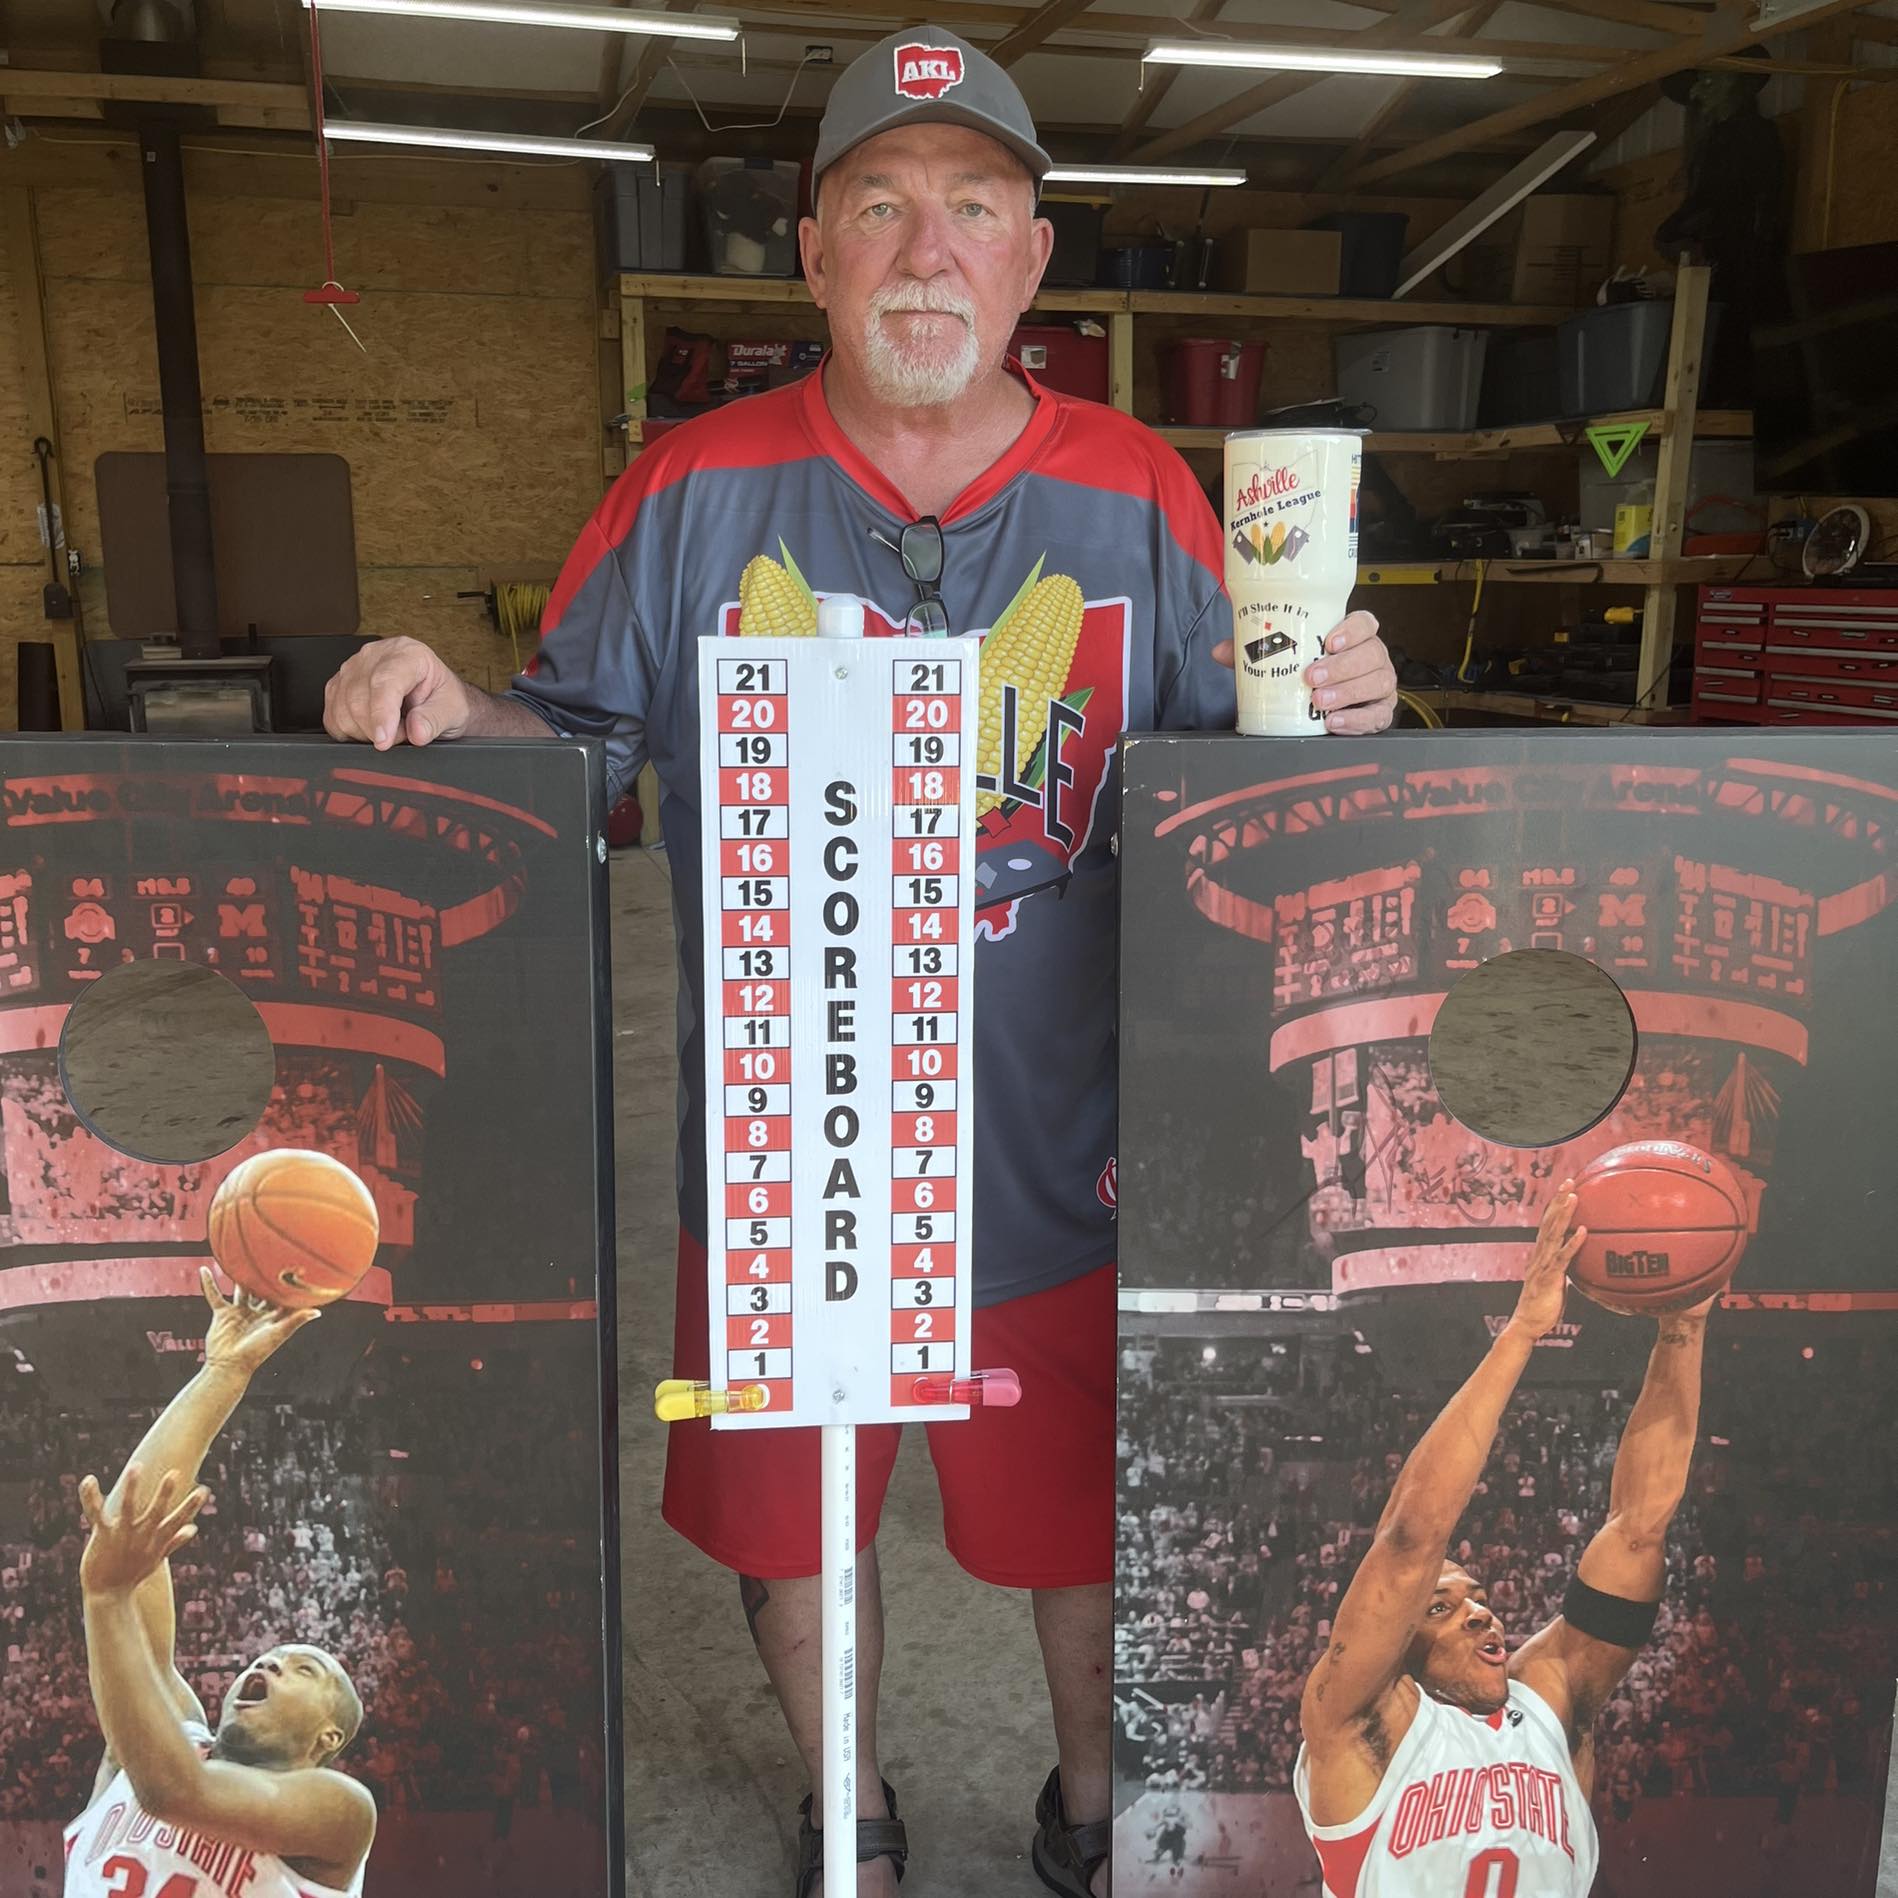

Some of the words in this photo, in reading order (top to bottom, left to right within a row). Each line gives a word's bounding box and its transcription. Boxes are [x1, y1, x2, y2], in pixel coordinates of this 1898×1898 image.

[901, 60, 957, 83] AKL
[1237, 467, 1300, 511] Ashville
[1230, 506, 1275, 532] Kernhole
[1277, 489, 1321, 511] League
[1250, 602, 1279, 614] Slide
[736, 664, 769, 690] 21
[911, 665, 943, 691] 21
[1242, 660, 1267, 679] Your
[1271, 663, 1300, 678] Hole
[732, 700, 774, 728] 20
[906, 700, 948, 728] 20
[736, 737, 771, 764] 19
[910, 737, 943, 763] 19
[737, 772, 772, 800] 18
[910, 772, 944, 800] 18
[739, 810, 770, 835] 17
[911, 808, 941, 834] 17
[737, 844, 772, 871] 16
[909, 843, 943, 870] 16
[739, 880, 772, 906] 15
[909, 879, 942, 904] 15
[739, 915, 773, 941] 14
[909, 913, 942, 939] 14
[740, 950, 773, 976] 13
[909, 948, 941, 973] 13
[740, 985, 773, 1011] 12
[909, 982, 941, 1008] 12
[745, 1020, 769, 1044] 11
[822, 781, 861, 1302] SCOREBOARD
[913, 1016, 937, 1041] 11
[740, 1053, 775, 1079] 10
[908, 1049, 942, 1075] 10
[749, 1088, 767, 1113] 9
[916, 1083, 934, 1108] 9
[749, 1121, 767, 1146] 8
[915, 1116, 934, 1142] 8
[750, 1155, 766, 1179] 7
[916, 1150, 932, 1174] 7
[749, 1187, 768, 1213] 6
[915, 1182, 933, 1208] 6
[750, 1221, 768, 1246] 5
[915, 1216, 932, 1239] 5
[749, 1254, 769, 1278] 4
[914, 1248, 933, 1272] 4
[750, 1286, 769, 1312] 3
[915, 1281, 932, 1305] 3
[750, 1320, 769, 1345] 2
[914, 1313, 932, 1338] 2
[754, 1352, 766, 1376] 1
[918, 1346, 928, 1369] 1
[1388, 1766, 1488, 1861] OHIO
[1488, 1762, 1575, 1865] STATE
